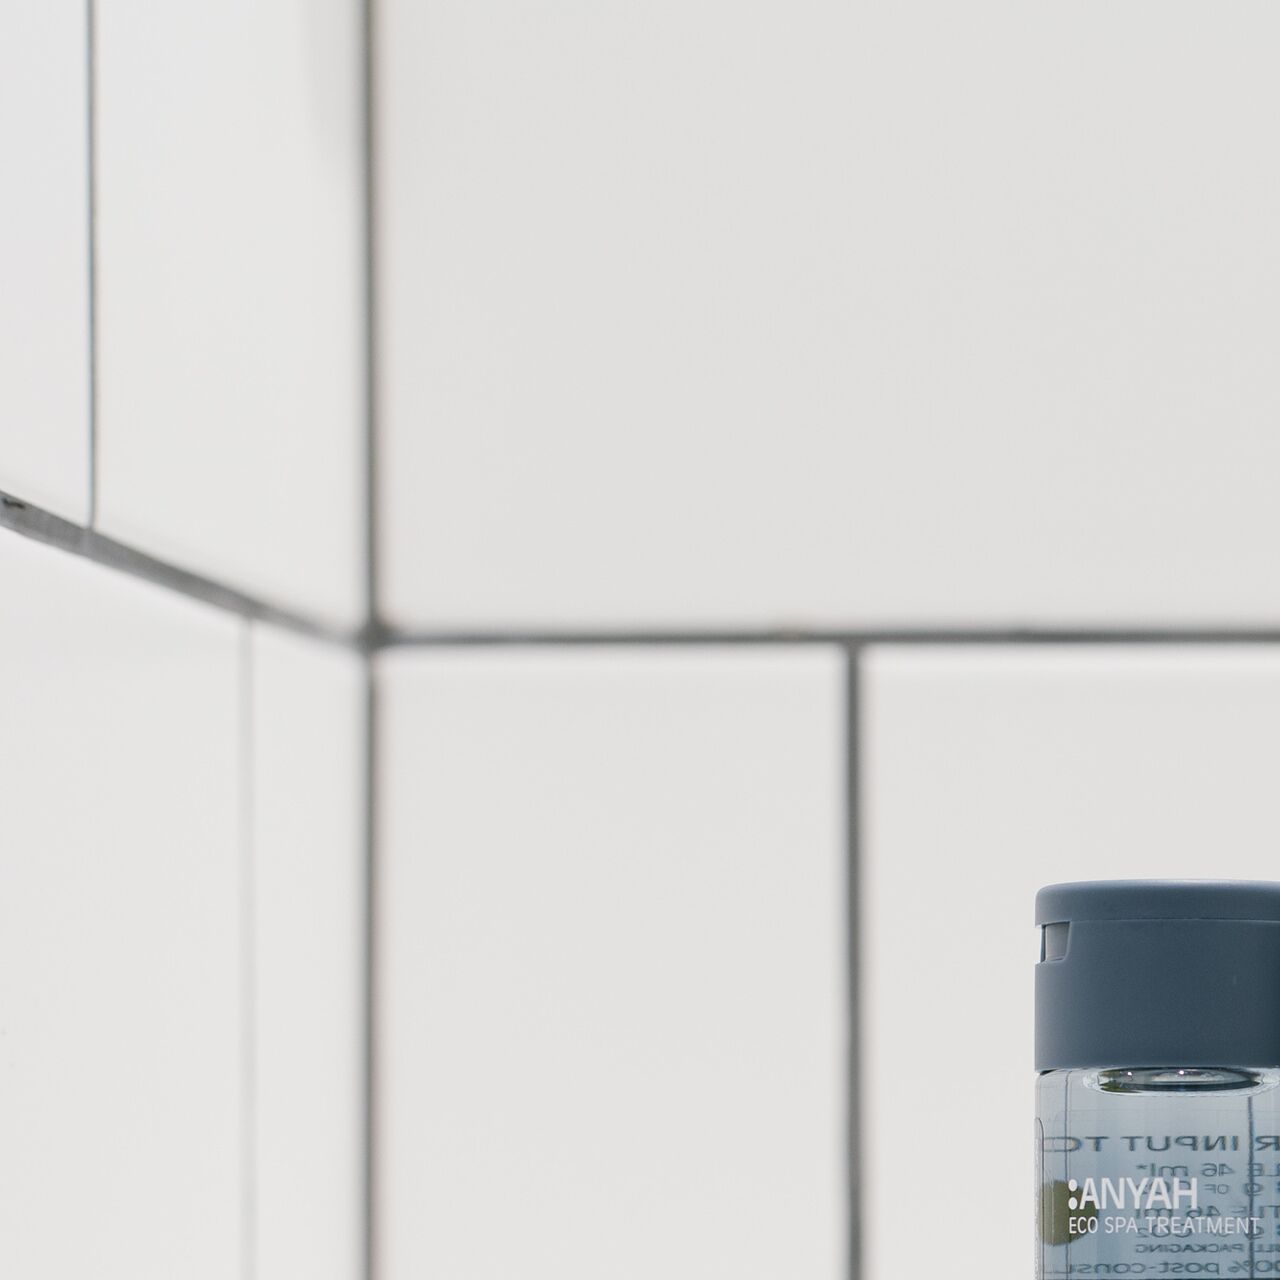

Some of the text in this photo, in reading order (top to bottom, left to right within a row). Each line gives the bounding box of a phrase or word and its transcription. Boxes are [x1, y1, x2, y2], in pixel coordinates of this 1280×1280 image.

[1069, 1217, 1260, 1234] ECO SPA TREATMENT
